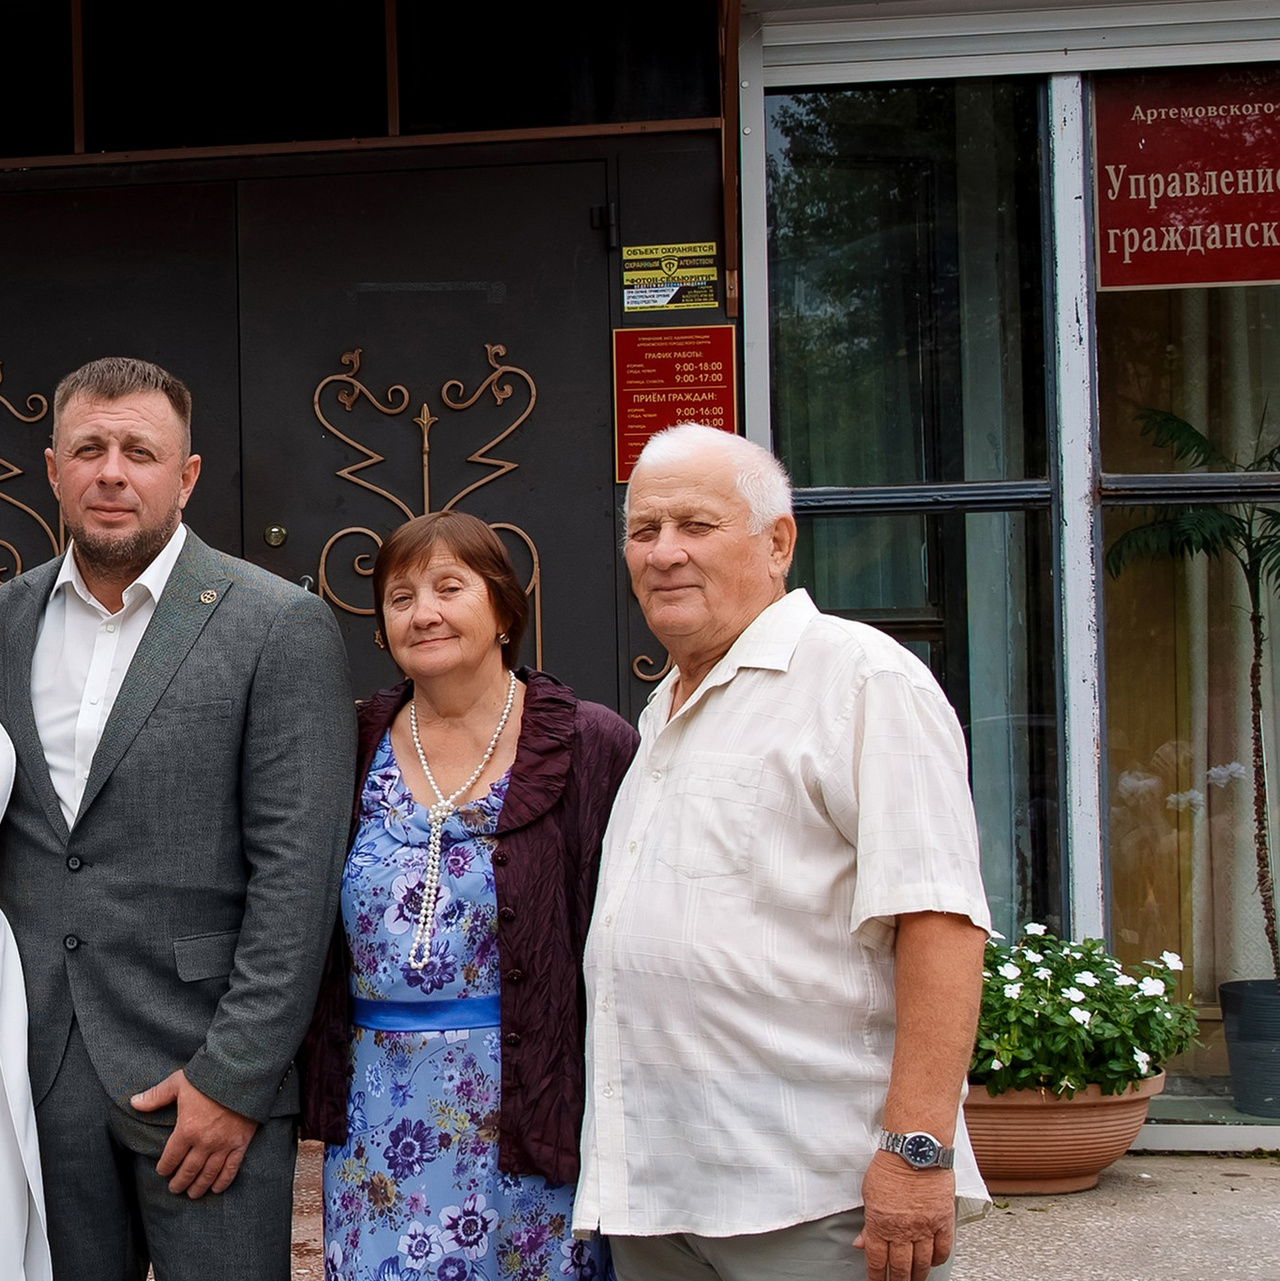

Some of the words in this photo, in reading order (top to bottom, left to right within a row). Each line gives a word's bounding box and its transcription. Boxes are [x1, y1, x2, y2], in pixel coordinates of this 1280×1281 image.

[1131, 102, 1275, 124] Артемовского
[626, 248, 659, 256] ОБЪЕКТ
[661, 245, 714, 254] ОХРАНЯЕТСЯ
[675, 362, 723, 371] 9:00-18:00
[675, 373, 723, 383] 9:00-17:00
[633, 392, 666, 403] ПРИЁМ
[668, 392, 717, 402] ГРАЖДАН:
[676, 406, 723, 416] 9:00-16:00
